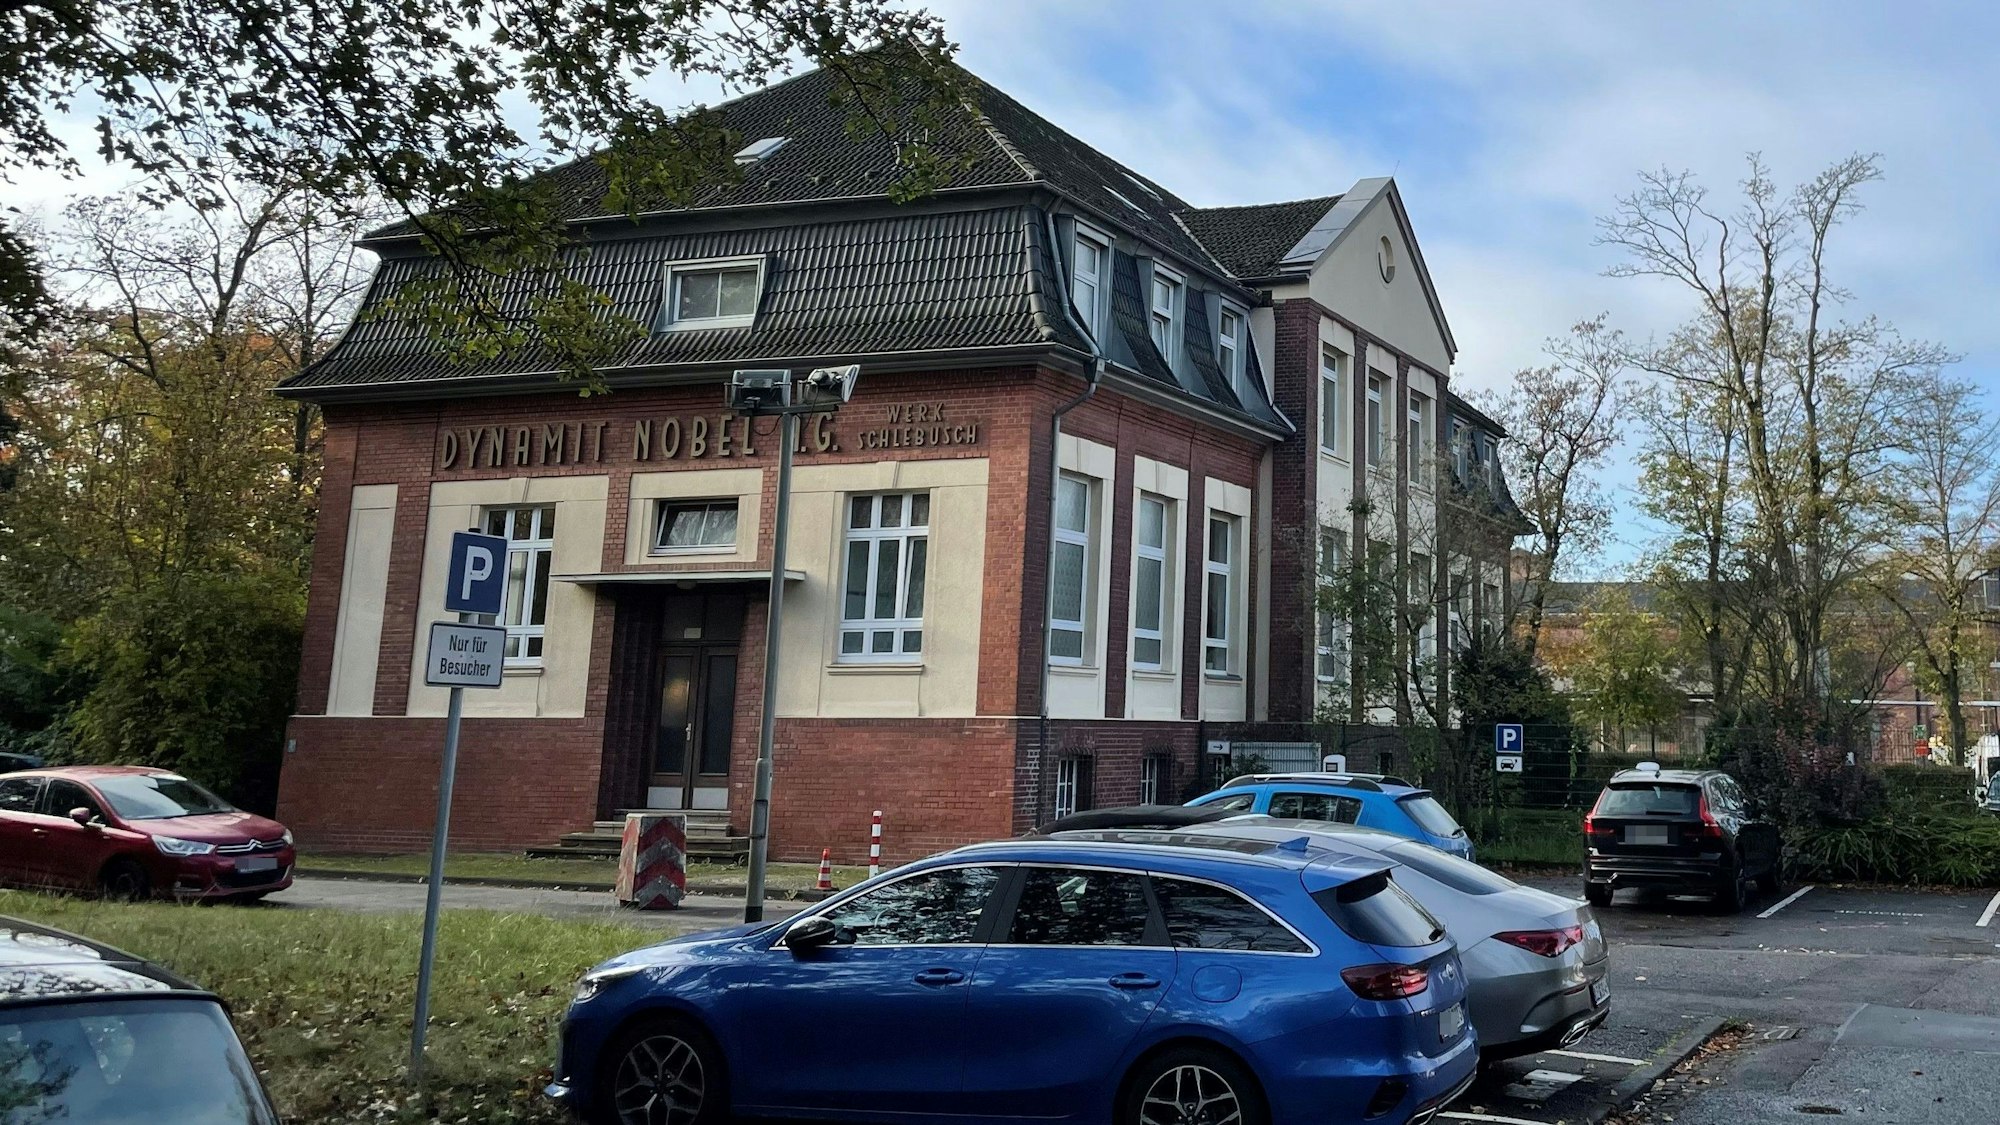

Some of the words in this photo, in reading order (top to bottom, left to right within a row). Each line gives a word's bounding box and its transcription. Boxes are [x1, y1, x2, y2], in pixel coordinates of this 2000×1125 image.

[886, 402, 944, 424] WERK
[440, 420, 608, 470] DYNAMIT
[633, 412, 755, 460] NOBEL
[857, 424, 978, 450] SCHLEBUSCH
[461, 545, 494, 601] P
[449, 634, 470, 653] Nur
[472, 636, 488, 653] für
[440, 657, 491, 677] Besucher
[1503, 728, 1517, 749] P
